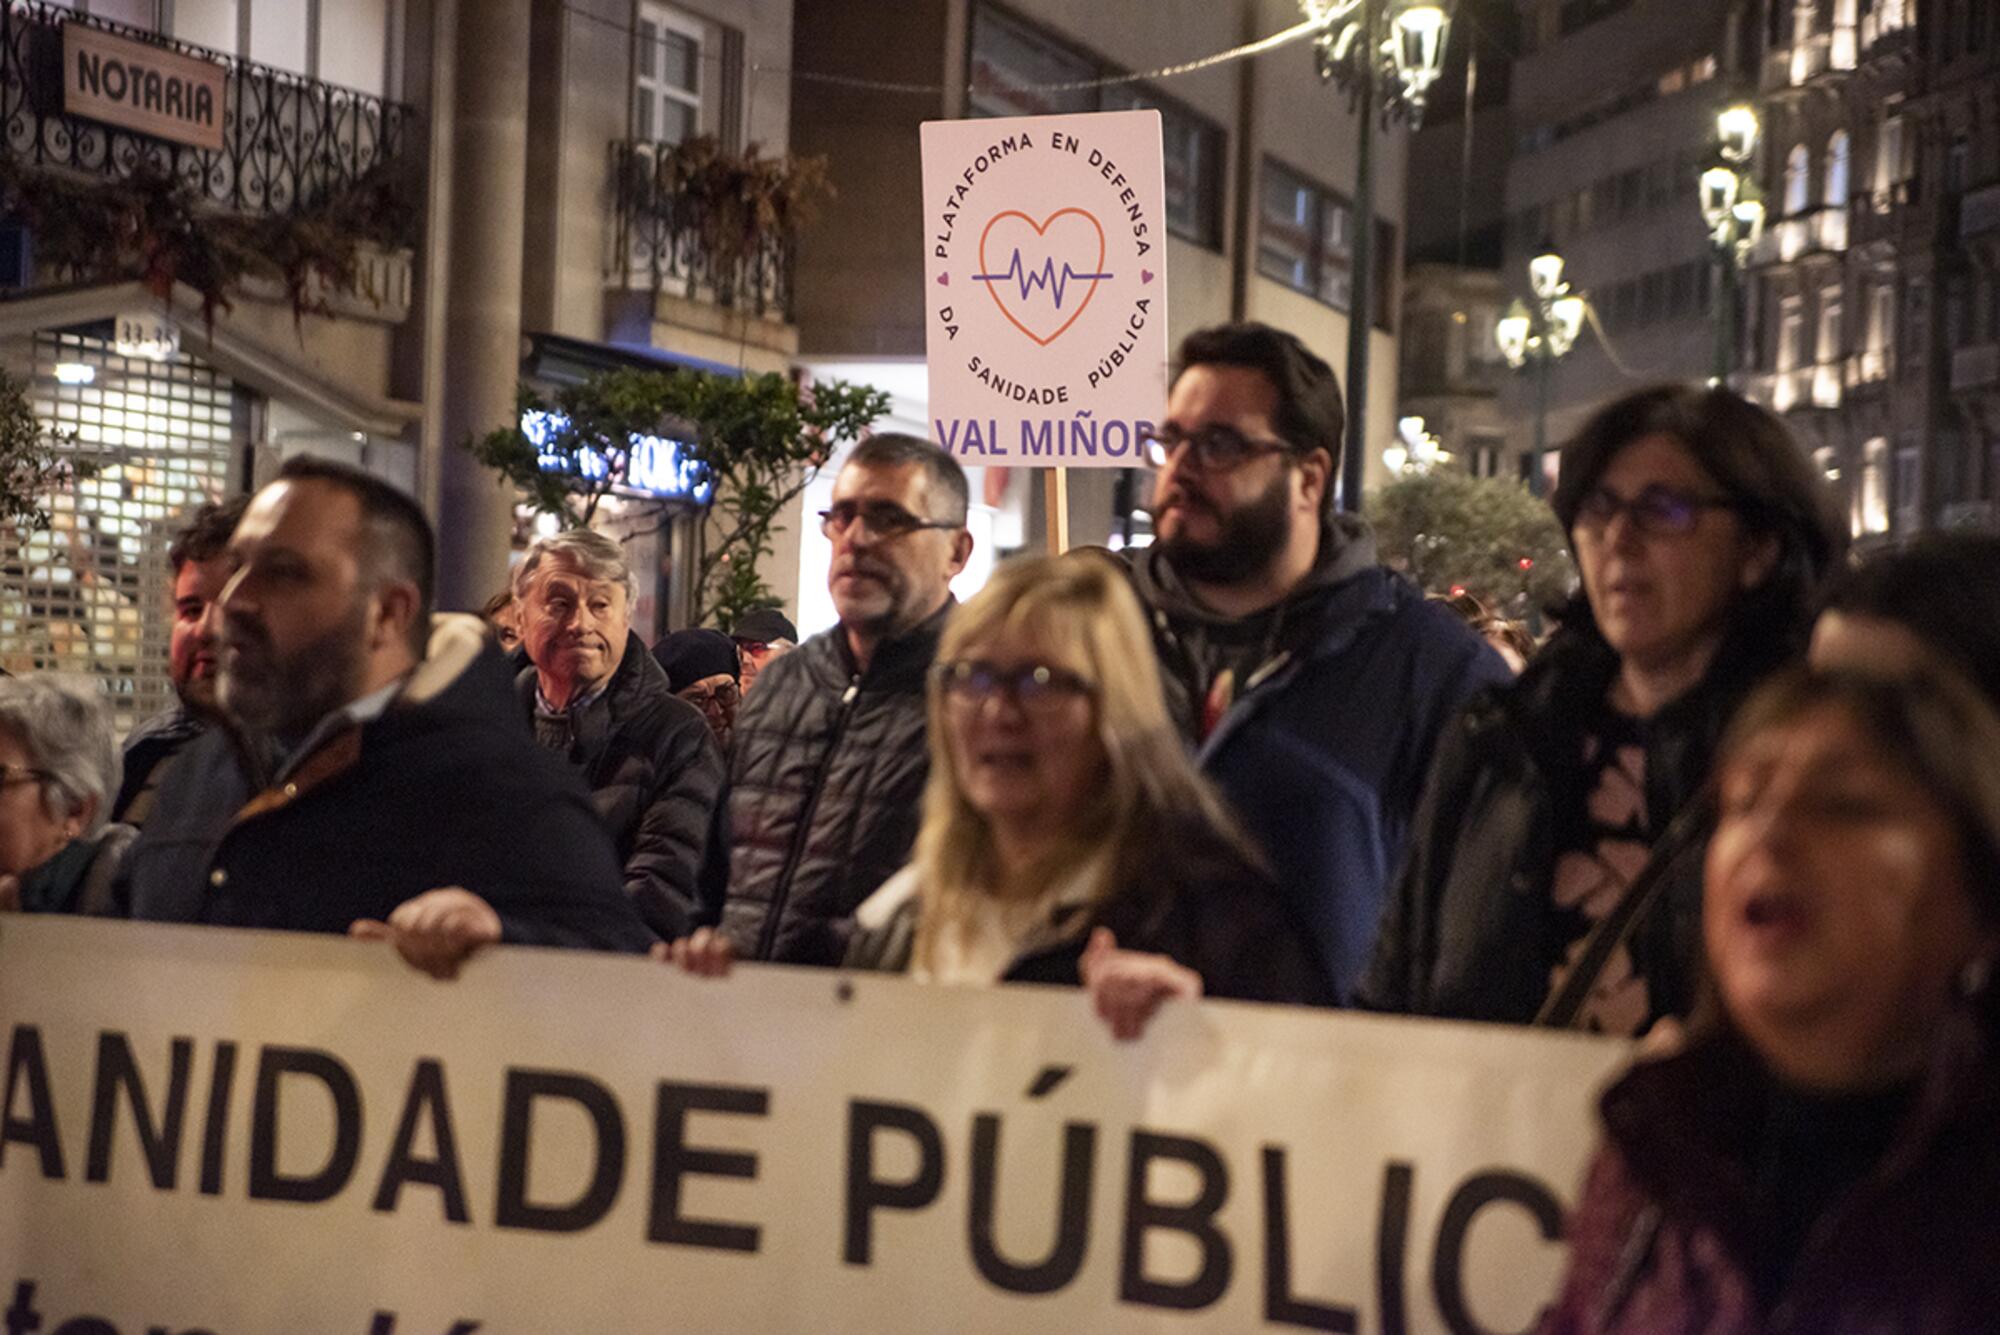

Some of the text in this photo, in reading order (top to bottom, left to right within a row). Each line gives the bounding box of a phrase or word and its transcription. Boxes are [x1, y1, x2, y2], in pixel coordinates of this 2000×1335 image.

[77, 49, 214, 127] NOTARIA
[935, 132, 1151, 258] PLATAFORMA EN DEFENSA
[939, 298, 1151, 405] DA SANIDADE PÚBLICA
[935, 419, 1008, 456] VAL
